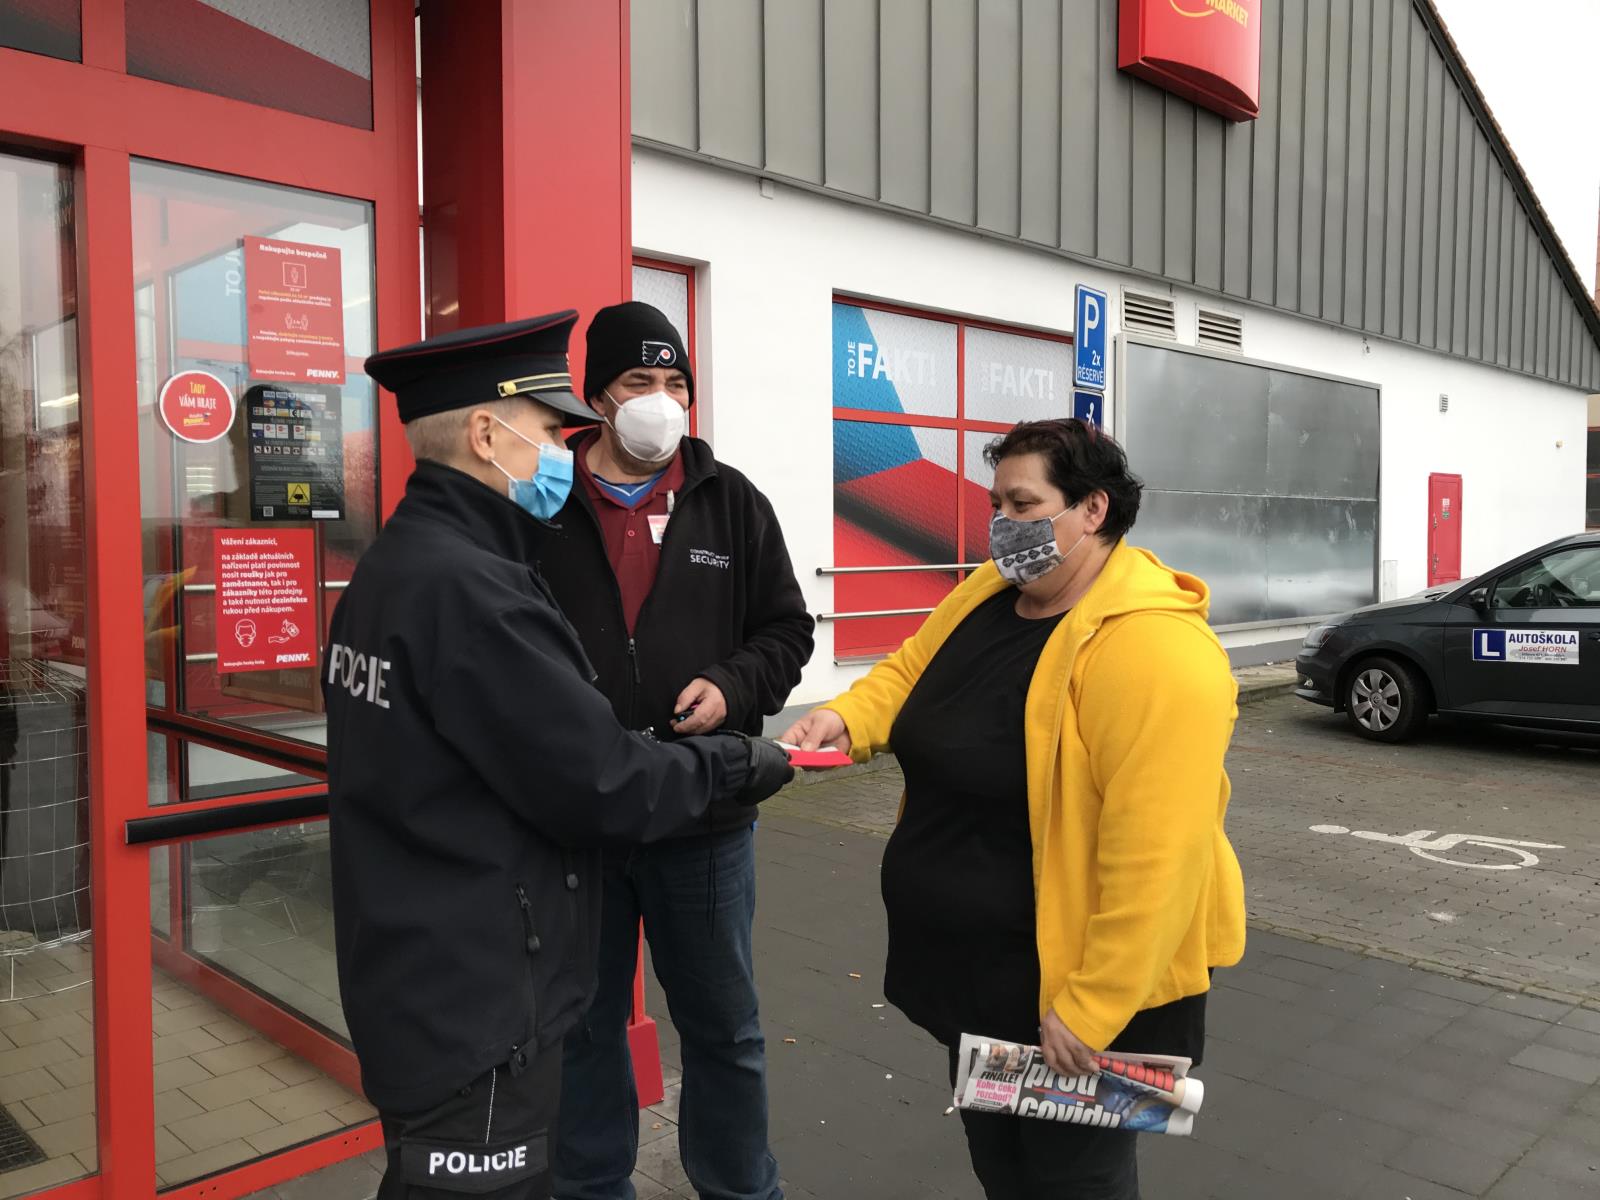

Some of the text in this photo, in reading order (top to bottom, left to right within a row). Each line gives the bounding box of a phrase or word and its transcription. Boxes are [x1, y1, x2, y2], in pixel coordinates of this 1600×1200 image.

[1084, 295, 1100, 348] P
[847, 341, 856, 377] TO JE
[858, 342, 937, 386] FAKT!
[1091, 350, 1101, 367] 2x
[990, 362, 1054, 401] FAKT!
[221, 537, 244, 545] Vážení
[232, 552, 258, 560] základě
[690, 554, 729, 569] SECURITY
[240, 571, 264, 579] roušky
[222, 589, 257, 597] zákazníky
[273, 588, 303, 596] prodejny
[244, 606, 260, 615] před
[1482, 631, 1577, 656] L AUTOŠKOLA
[980, 1071, 1020, 1085] FINALE!
[429, 1146, 527, 1175] POLICIE
